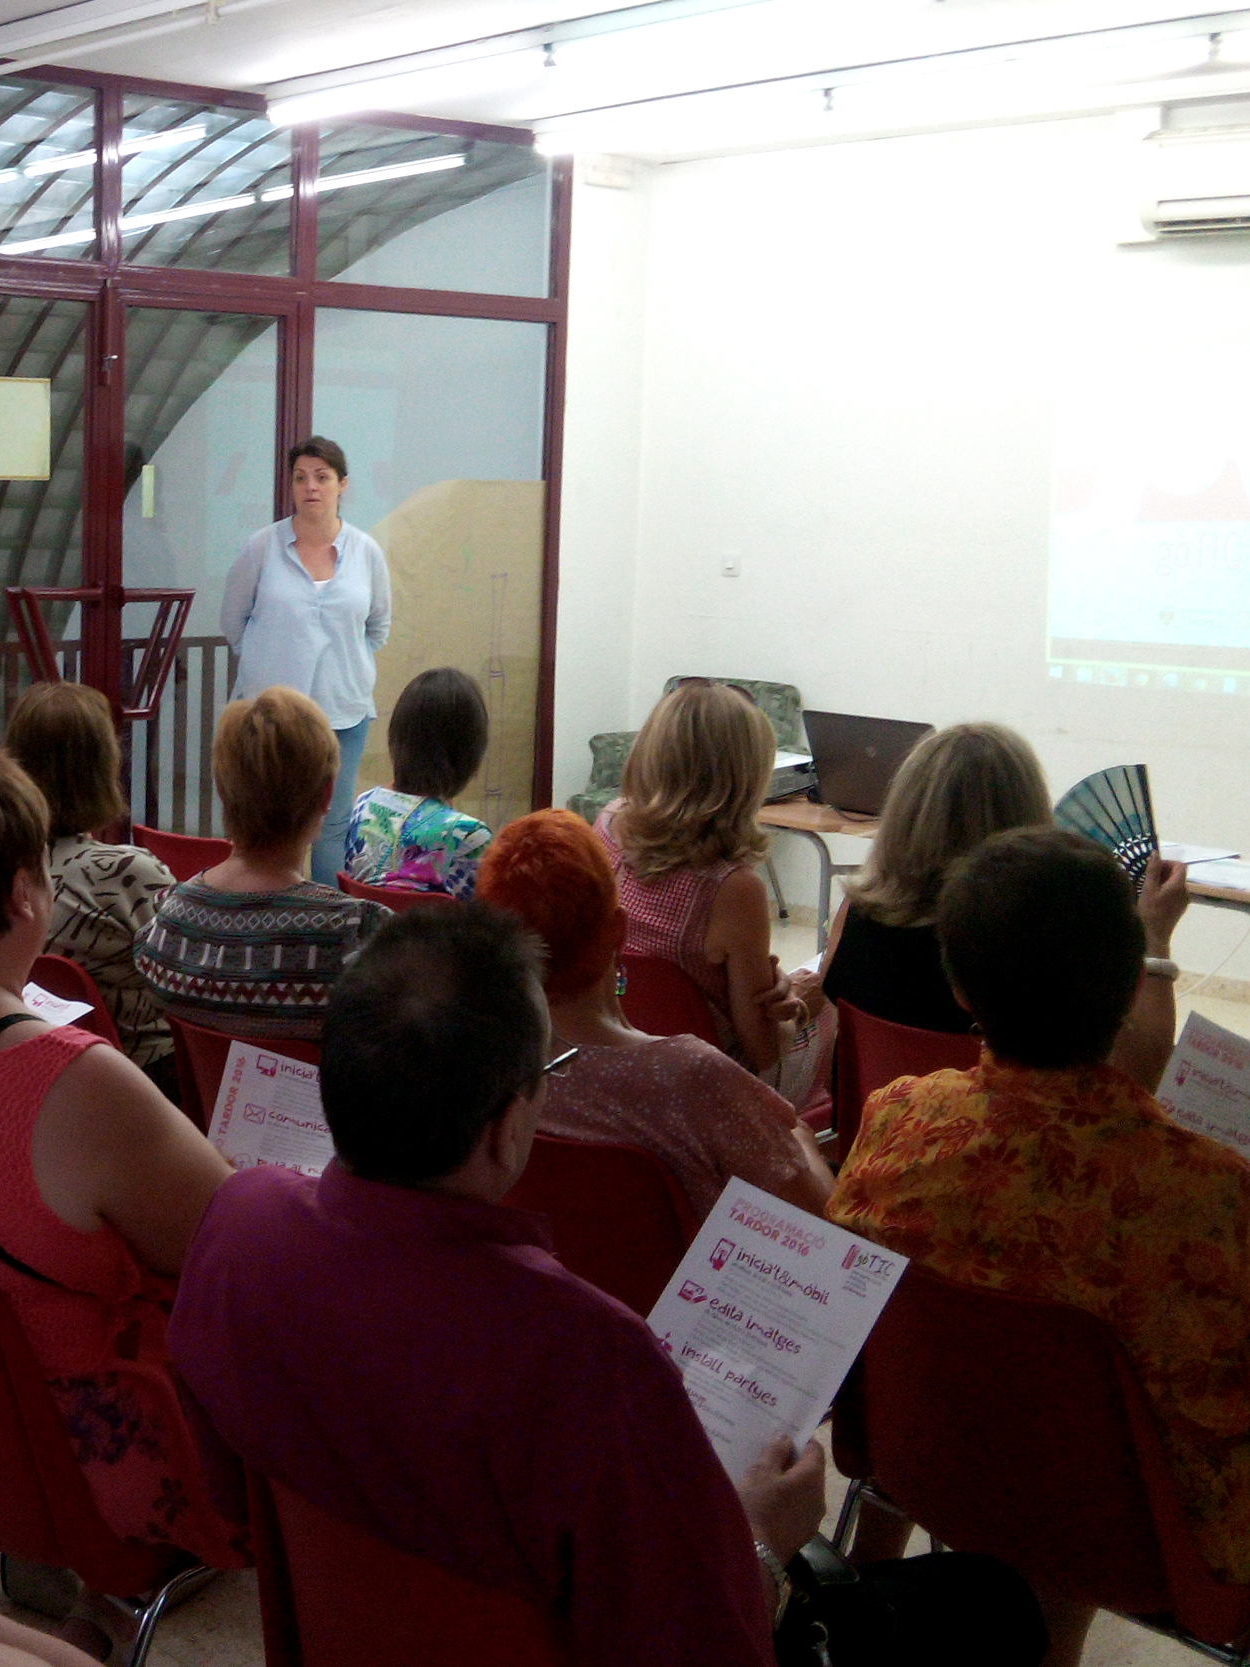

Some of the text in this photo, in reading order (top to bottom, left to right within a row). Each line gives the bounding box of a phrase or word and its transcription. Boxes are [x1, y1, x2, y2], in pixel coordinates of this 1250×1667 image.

[729, 1207, 811, 1257] TARDOR 2016
[709, 1296, 803, 1355] edita imatges
[681, 1341, 723, 1374] install
[725, 1368, 778, 1407] partyes
